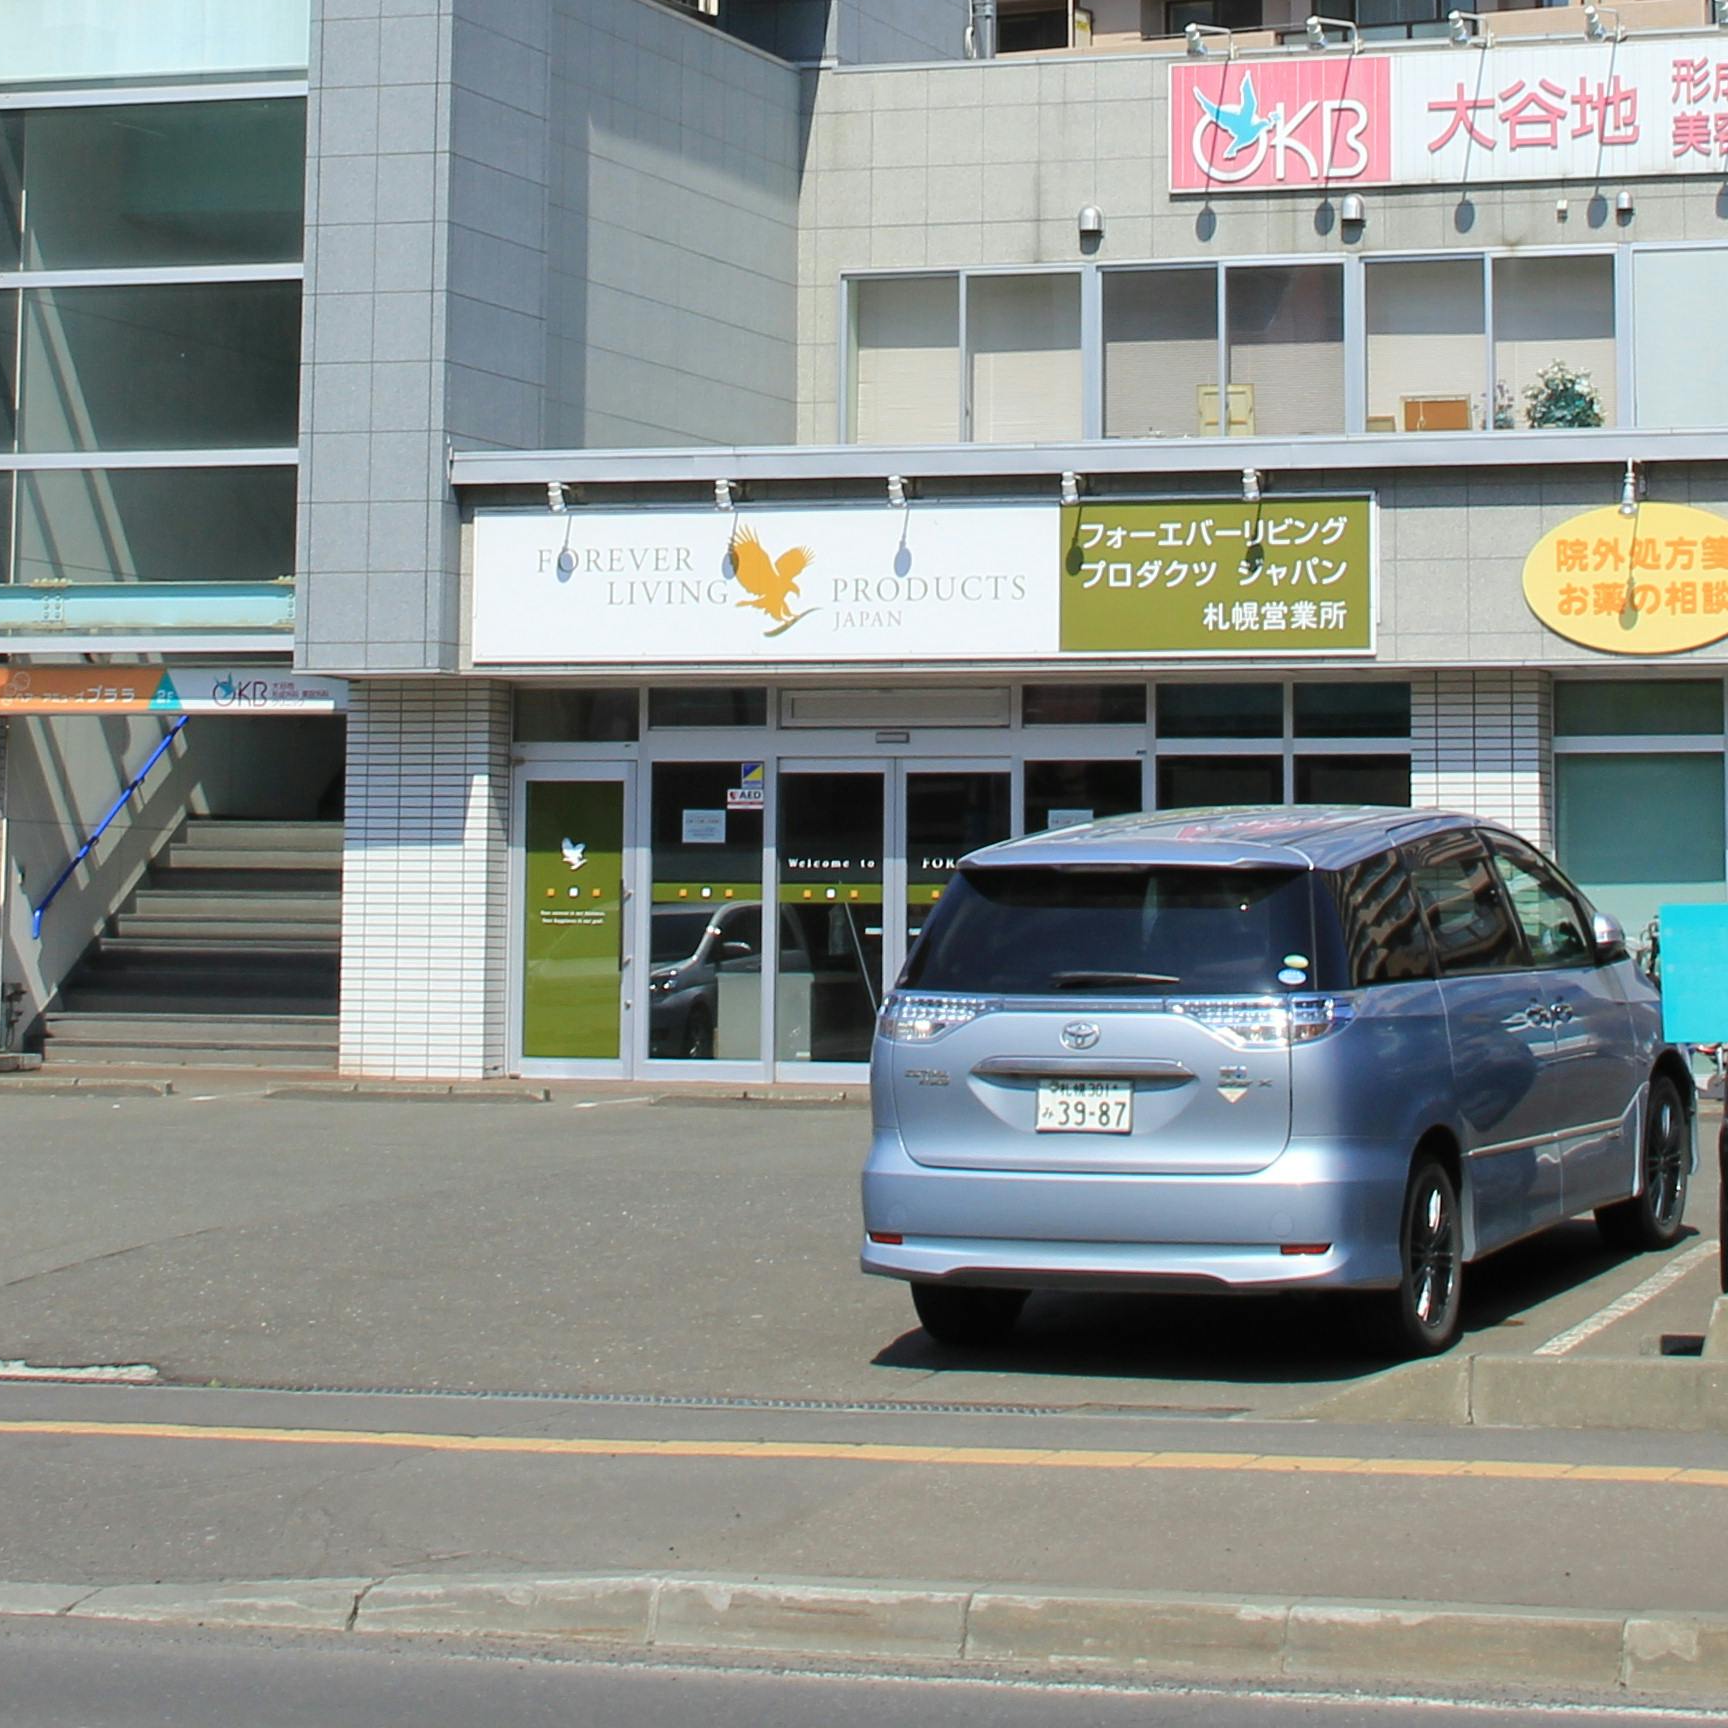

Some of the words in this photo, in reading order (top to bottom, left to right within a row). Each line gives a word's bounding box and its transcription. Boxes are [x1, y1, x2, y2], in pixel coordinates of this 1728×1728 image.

[1427, 75, 1640, 154] 大谷地
[1192, 96, 1369, 184] OKB
[1080, 515, 1349, 549] フォーエバーリビング
[537, 547, 694, 574] FOREVER
[1080, 557, 1218, 590] プロダクツ
[1238, 554, 1348, 587] ジャパン
[607, 577, 731, 606] LIVING
[831, 575, 1028, 603] PRODUCTS
[831, 610, 905, 632] JAPAN
[1201, 599, 1348, 633] 札幌営業所
[739, 790, 762, 800] AED
[787, 857, 850, 869] Welcome
[860, 858, 876, 869] to
[1058, 1100, 1127, 1128] 39-87
